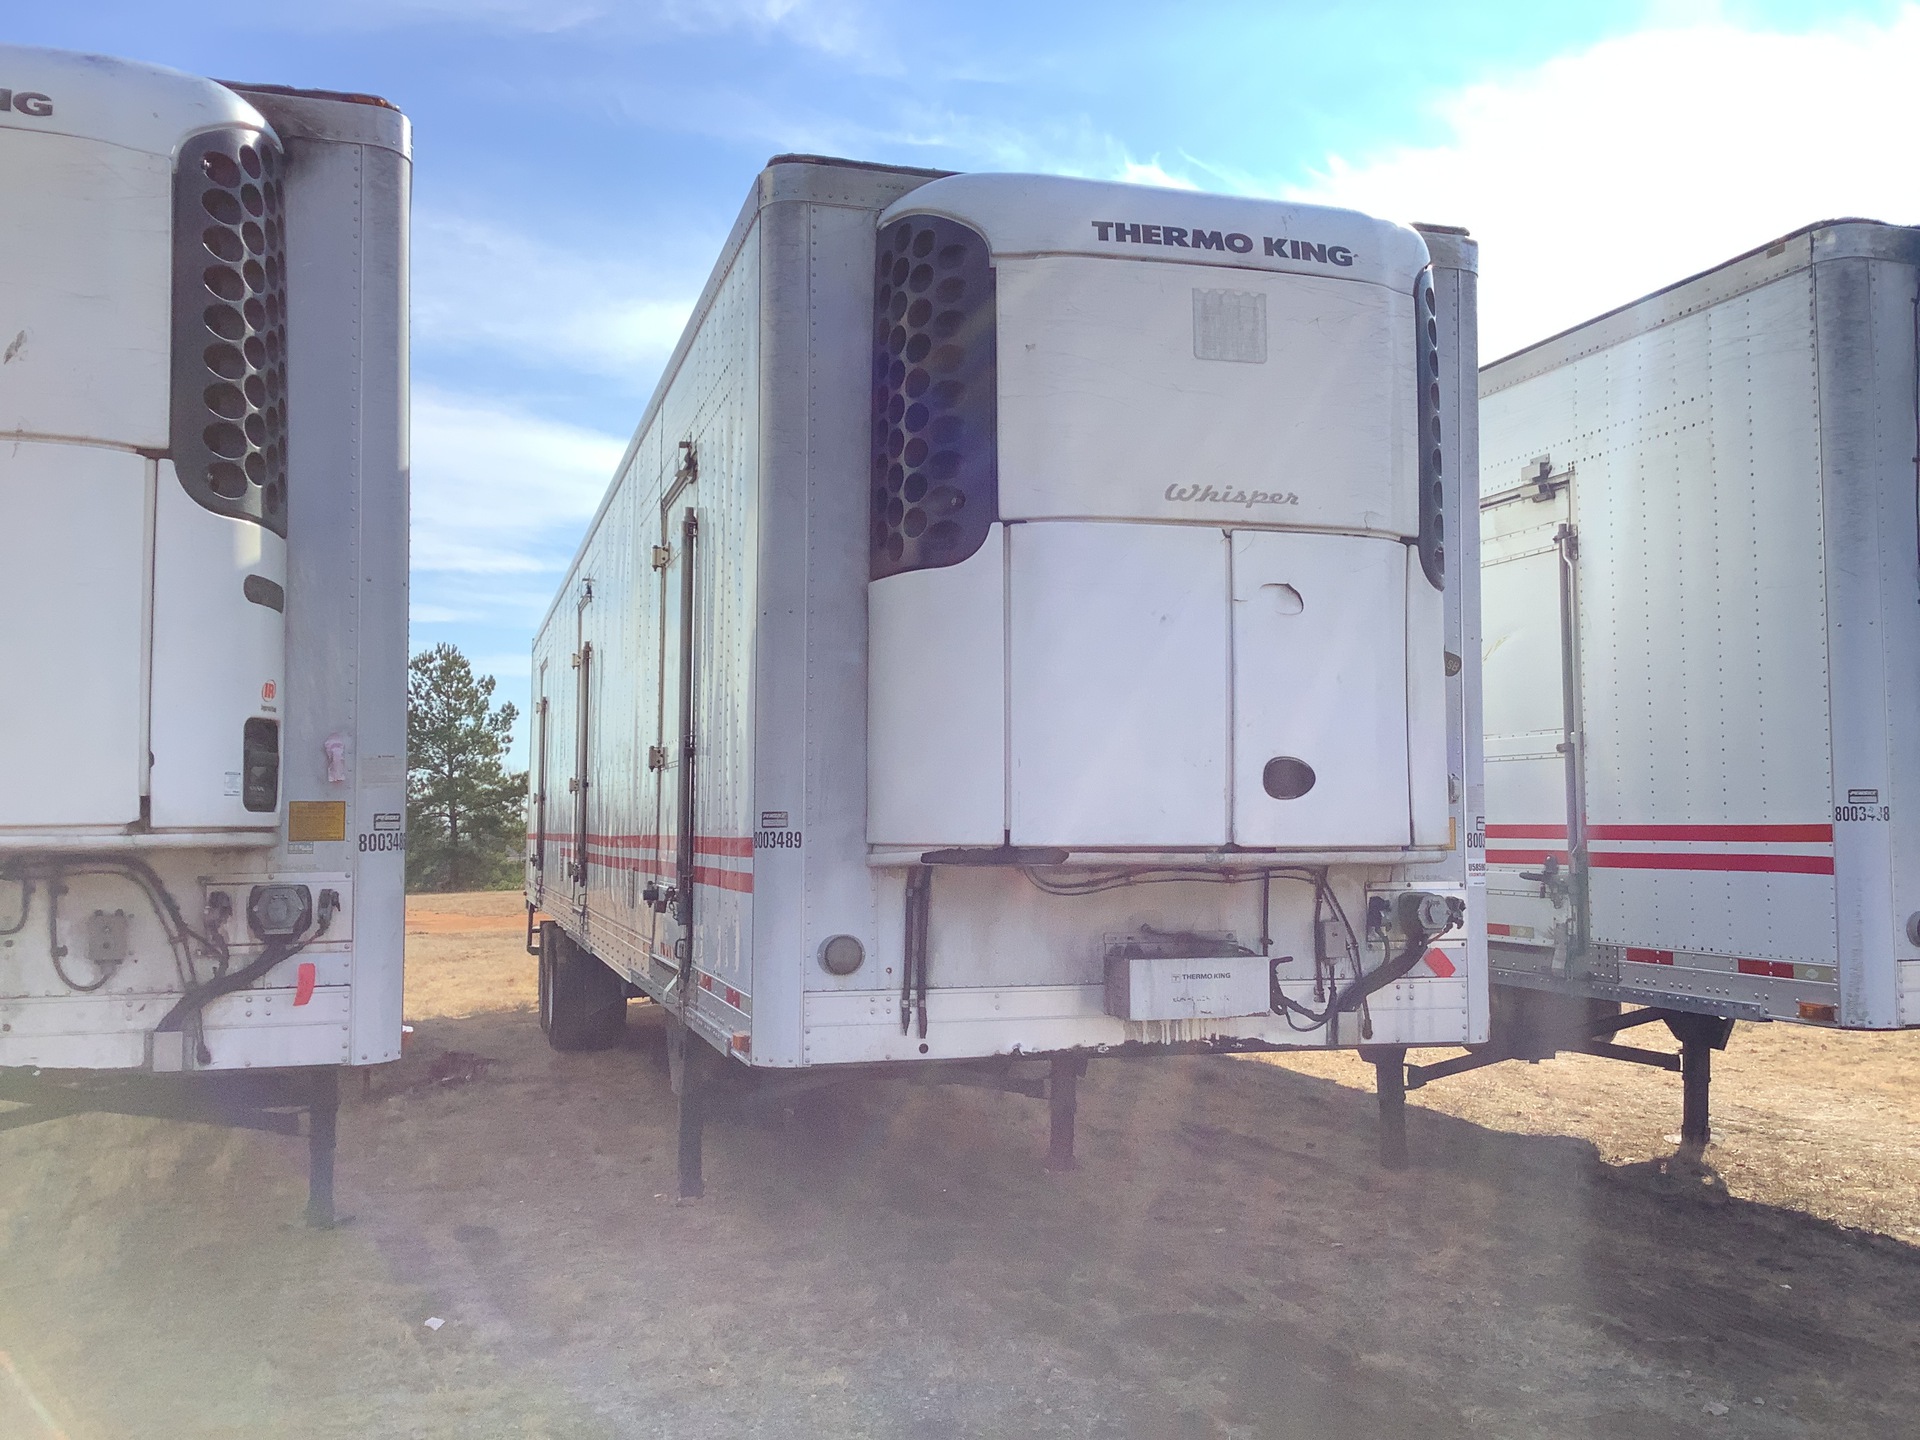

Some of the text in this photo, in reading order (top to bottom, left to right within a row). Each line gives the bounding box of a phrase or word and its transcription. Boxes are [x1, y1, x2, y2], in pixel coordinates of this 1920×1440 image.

[1091, 221, 1353, 267] THERMO KING
[1164, 483, 1299, 508] Whisper
[358, 833, 406, 852] 800348
[754, 831, 802, 849] 8003489
